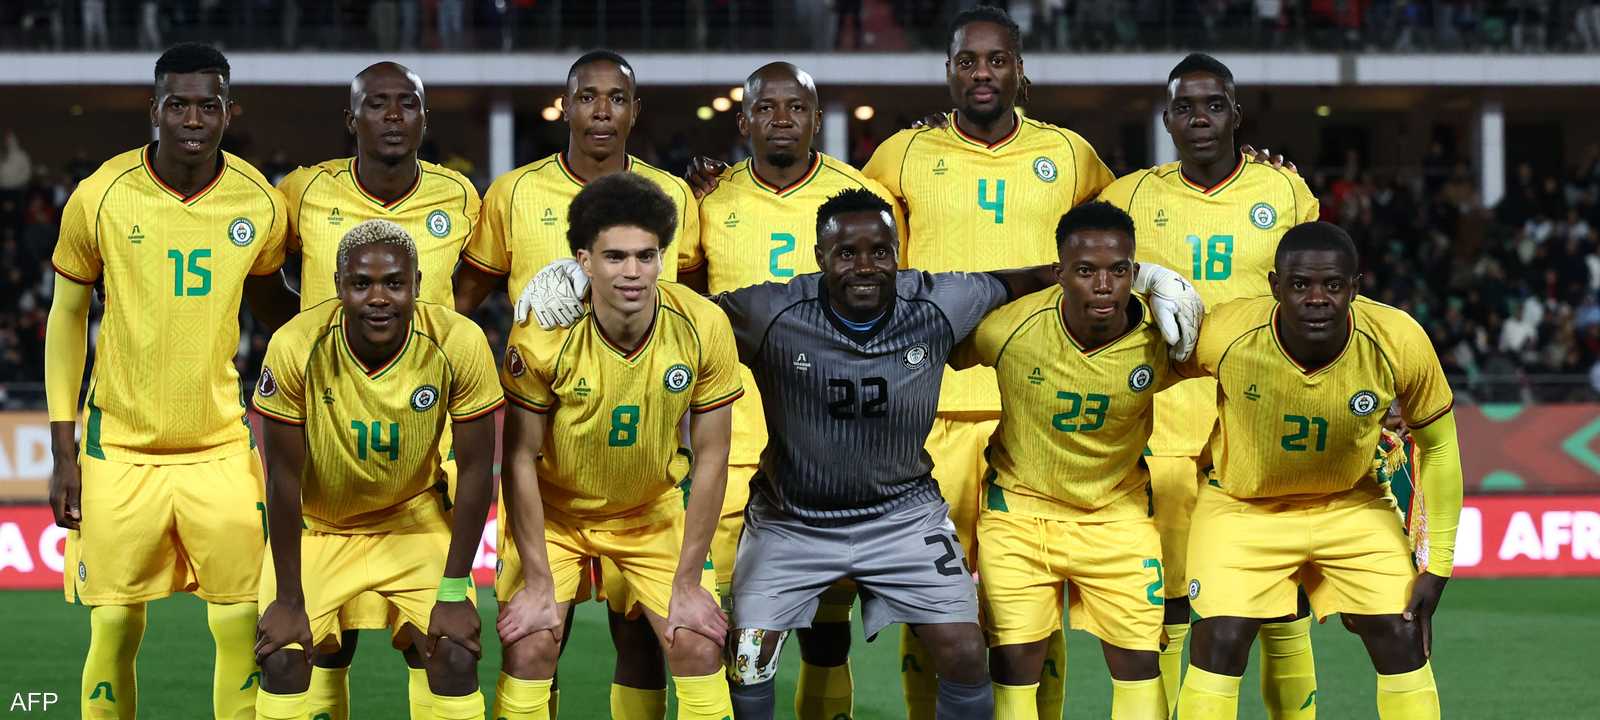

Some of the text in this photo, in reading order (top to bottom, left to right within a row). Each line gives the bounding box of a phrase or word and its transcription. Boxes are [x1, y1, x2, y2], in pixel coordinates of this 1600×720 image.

[976, 178, 1007, 225] 4
[168, 248, 212, 297] 15
[769, 232, 797, 278] 2
[1185, 235, 1234, 281] 18
[828, 376, 888, 419] 22
[1052, 390, 1110, 433] 23
[351, 420, 400, 461] 14
[608, 404, 640, 448] 8
[1280, 414, 1328, 452] 21
[924, 534, 972, 576] 2
